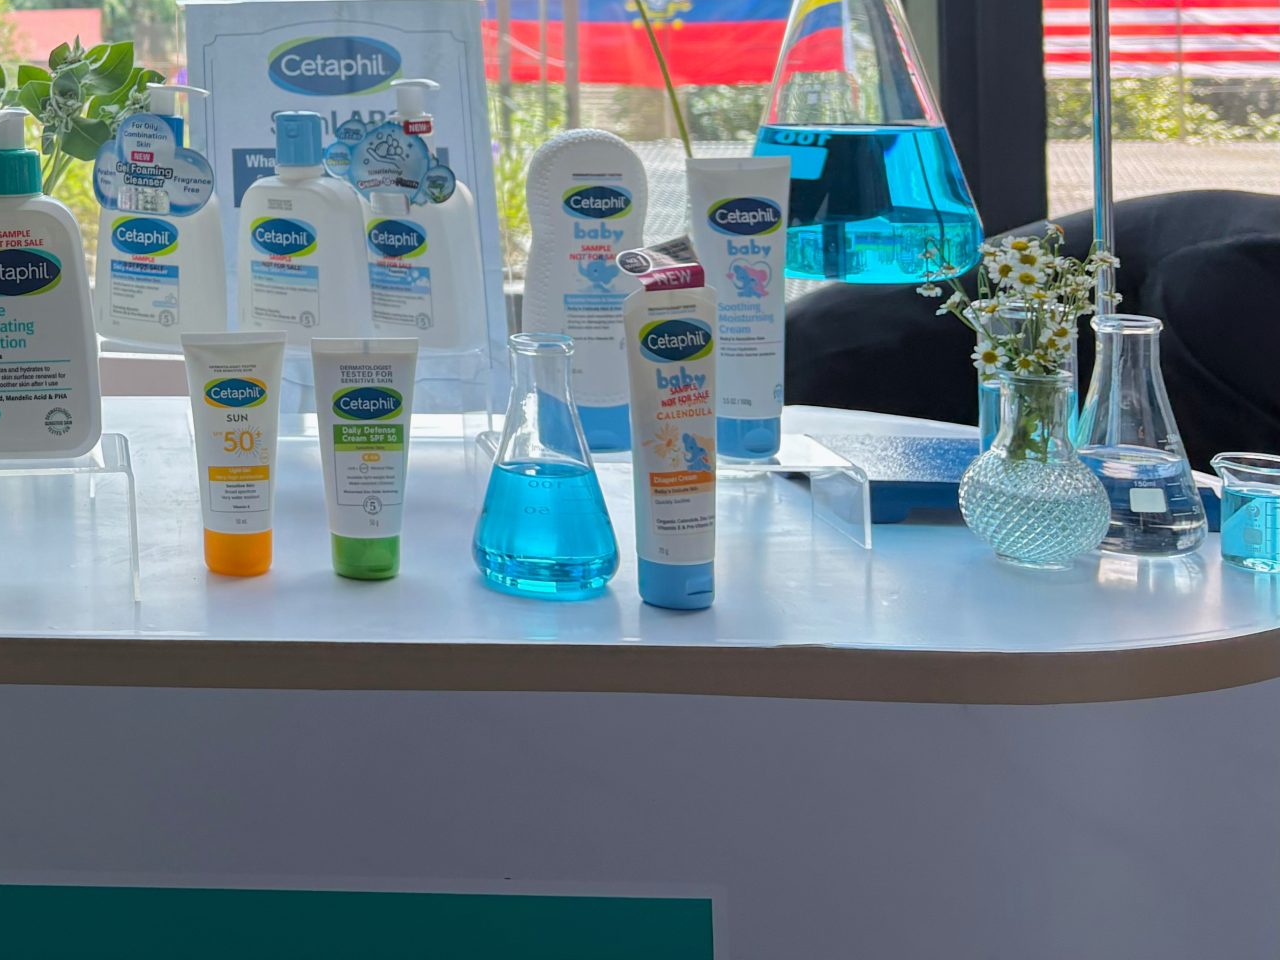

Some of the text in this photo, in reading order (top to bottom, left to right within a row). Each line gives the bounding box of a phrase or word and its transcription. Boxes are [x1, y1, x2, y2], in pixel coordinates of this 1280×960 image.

[280, 53, 387, 80] Cetaphil
[132, 121, 159, 131] For Oily
[124, 130, 168, 141] Combination
[136, 141, 152, 149] Skin
[134, 152, 152, 161] NEW
[245, 154, 276, 168] Wha
[116, 162, 173, 178] Gel Foaming
[124, 174, 165, 187] Cleanser
[173, 176, 212, 185] Fragrance
[183, 185, 200, 194] Free
[570, 196, 626, 210] Cetaphil
[715, 208, 776, 226] Cetaphil
[116, 227, 170, 246] Cetaphil
[255, 227, 308, 247] Cetaphil
[574, 221, 624, 244] baby
[5, 239, 23, 248] FOR
[24, 238, 44, 247] SALE
[370, 230, 419, 248] Cetaphil
[581, 244, 611, 252] SAMPLE
[727, 238, 772, 258] baby
[652, 270, 691, 286] NEW
[718, 302, 761, 313] Soothing
[719, 324, 752, 334] Cream
[647, 330, 705, 350] Cetaphil
[341, 370, 393, 378] TESTED FOR
[656, 366, 706, 390] baby
[210, 386, 260, 400] Cetaphil
[670, 383, 698, 395] SAMPLE
[340, 397, 394, 412] Cetaphil
[661, 390, 710, 408] NOT FOR SALE
[226, 413, 248, 422] SUN
[656, 408, 713, 420] CALENDULA
[342, 426, 396, 435] Daily Defense
[342, 434, 367, 442] Cream
[369, 434, 384, 442] SPF
[369, 501, 376, 511] 5
